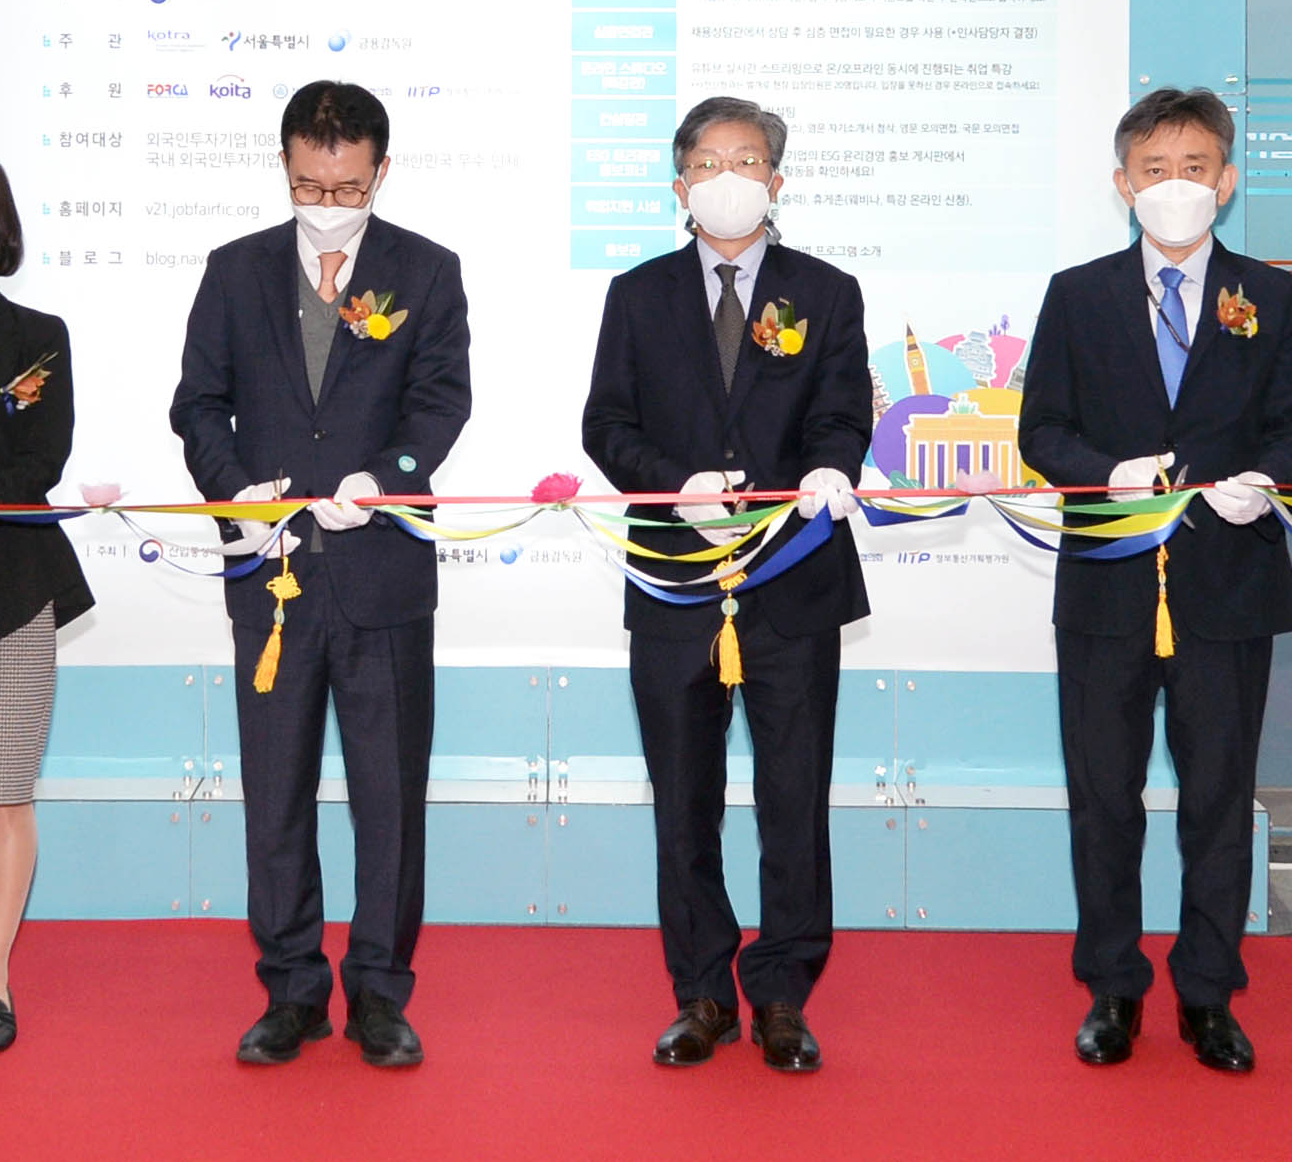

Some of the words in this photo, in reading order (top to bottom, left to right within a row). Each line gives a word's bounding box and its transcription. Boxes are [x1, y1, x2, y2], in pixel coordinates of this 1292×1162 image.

[243, 33, 310, 51] 서울특별시
[209, 82, 252, 99] koita
[60, 131, 123, 149] 참여대상
[146, 131, 248, 149] 외국인투자기업
[145, 151, 175, 169] 국내
[60, 200, 123, 218] 홈페이지
